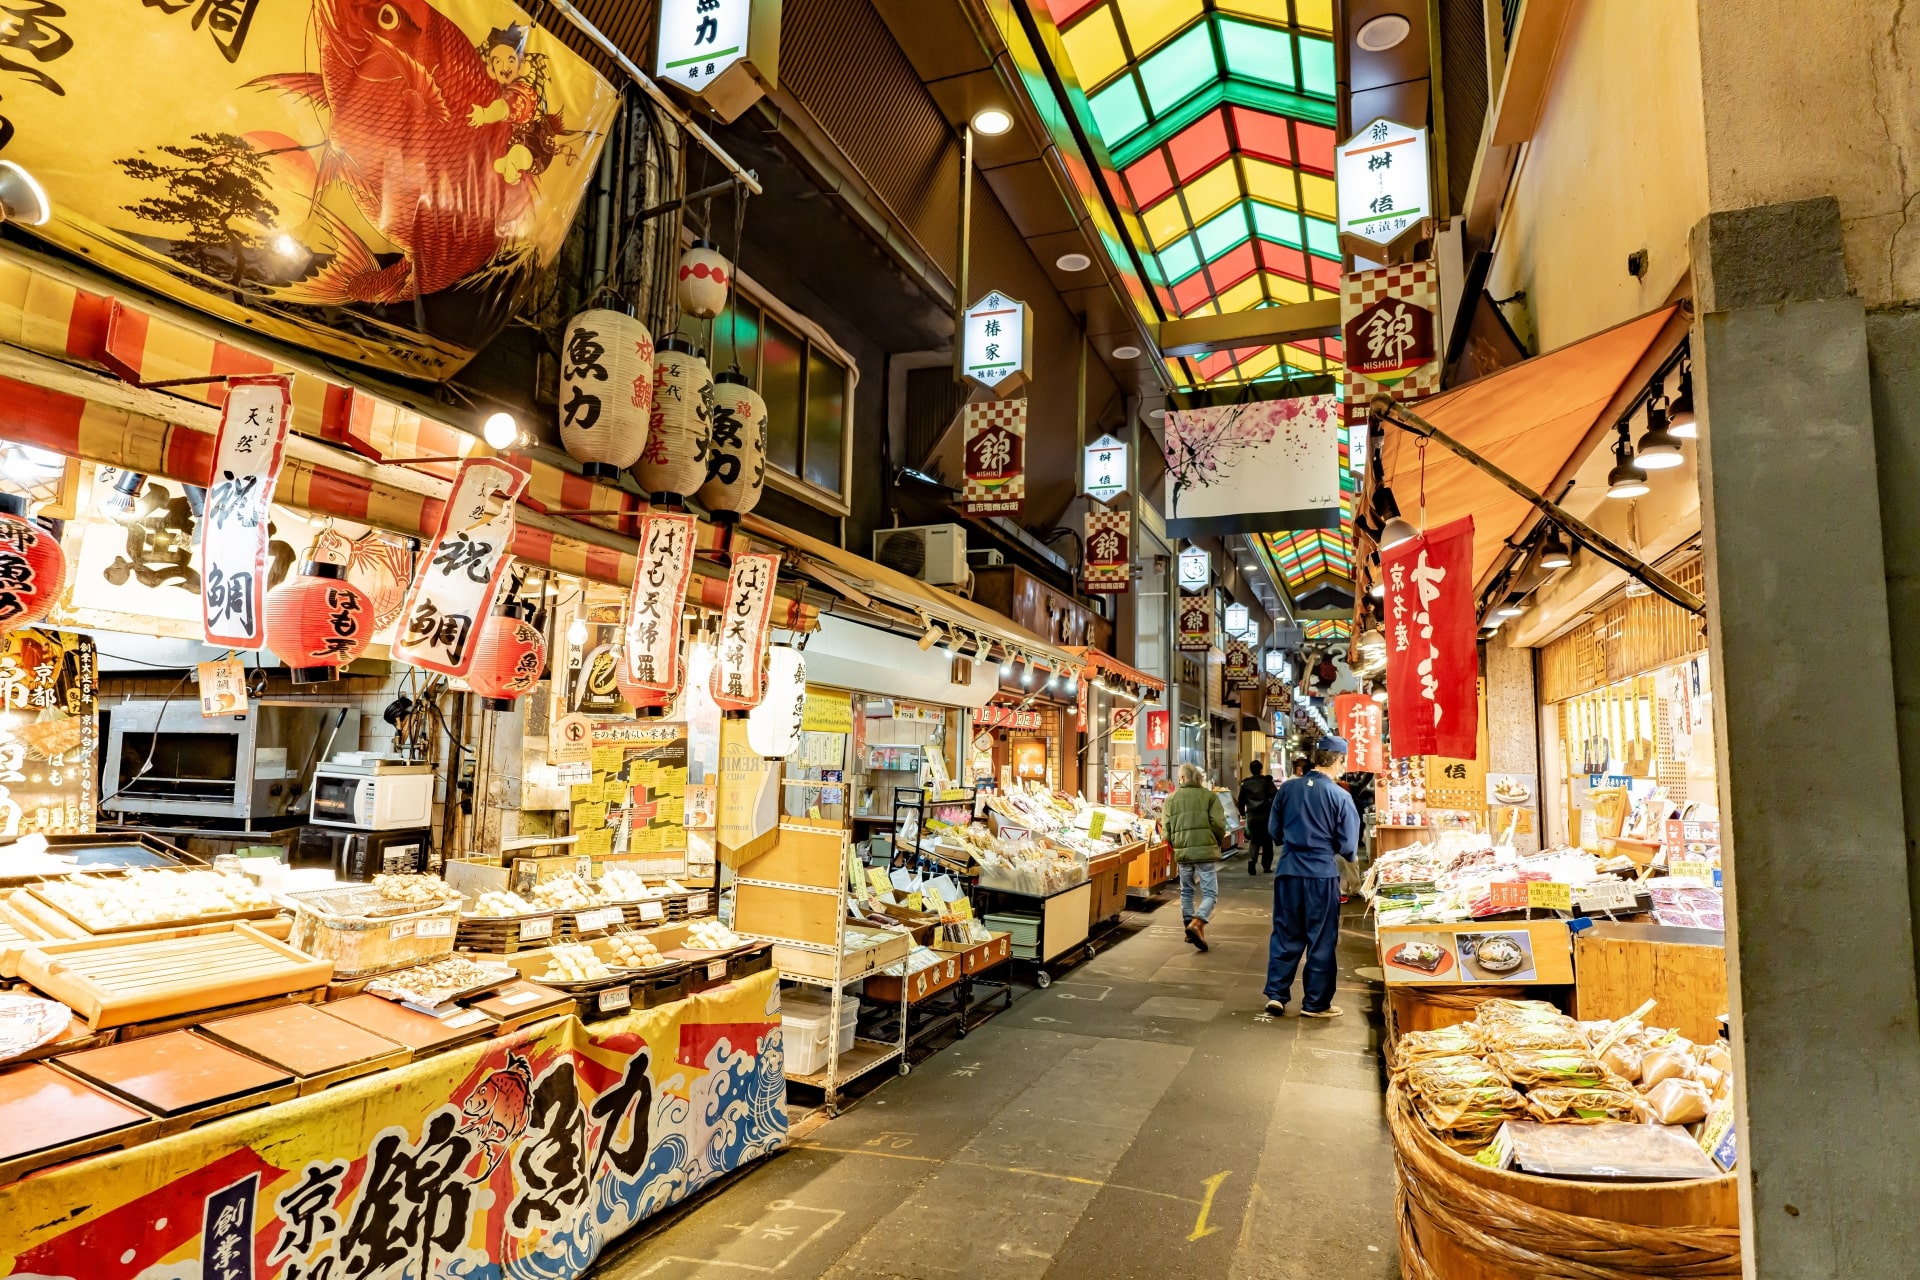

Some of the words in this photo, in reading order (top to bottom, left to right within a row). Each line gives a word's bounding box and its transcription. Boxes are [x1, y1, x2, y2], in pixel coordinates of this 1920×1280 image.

[688, 62, 715, 78] 焼魚
[984, 319, 1002, 360] 椿家
[1357, 303, 1415, 368] 錦
[563, 328, 608, 430] 魚力
[665, 364, 682, 402] 名代
[1363, 359, 1398, 370] NISHIKI
[736, 401, 751, 419] 錦
[234, 407, 260, 453] 天然
[973, 431, 1010, 478] 錦
[1091, 532, 1119, 565] 錦
[636, 528, 675, 684] はも天婦羅
[725, 563, 757, 698] はも天婦羅
[31, 663, 57, 706] 京都
[48, 752, 64, 787] はも
[1444, 763, 1467, 779] 悟
[603, 992, 625, 1004] ¥500
